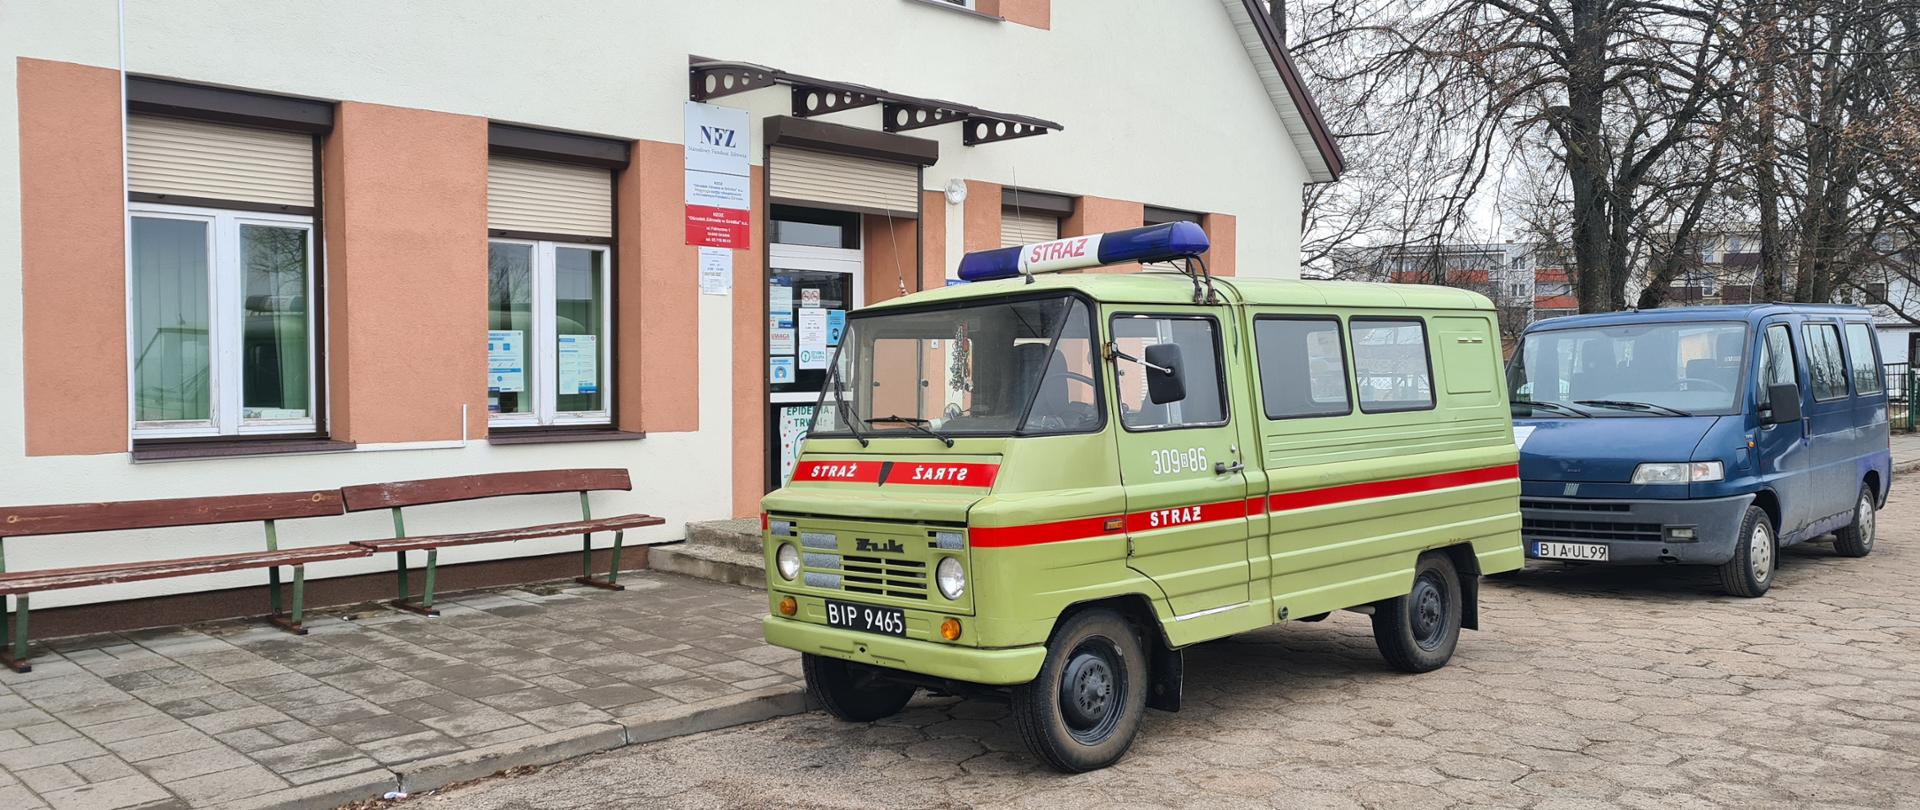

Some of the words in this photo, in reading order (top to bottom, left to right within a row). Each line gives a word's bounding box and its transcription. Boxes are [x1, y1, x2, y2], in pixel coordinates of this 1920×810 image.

[700, 125, 737, 148] NFZ
[1030, 239, 1088, 263] STRAŻ
[811, 463, 857, 477] STRAŻ
[1150, 506, 1201, 526] STRAŻ
[1540, 543, 1568, 557] BIA
[1573, 545, 1606, 559] UL99
[828, 603, 857, 626] BIP
[864, 608, 903, 634] 9465
